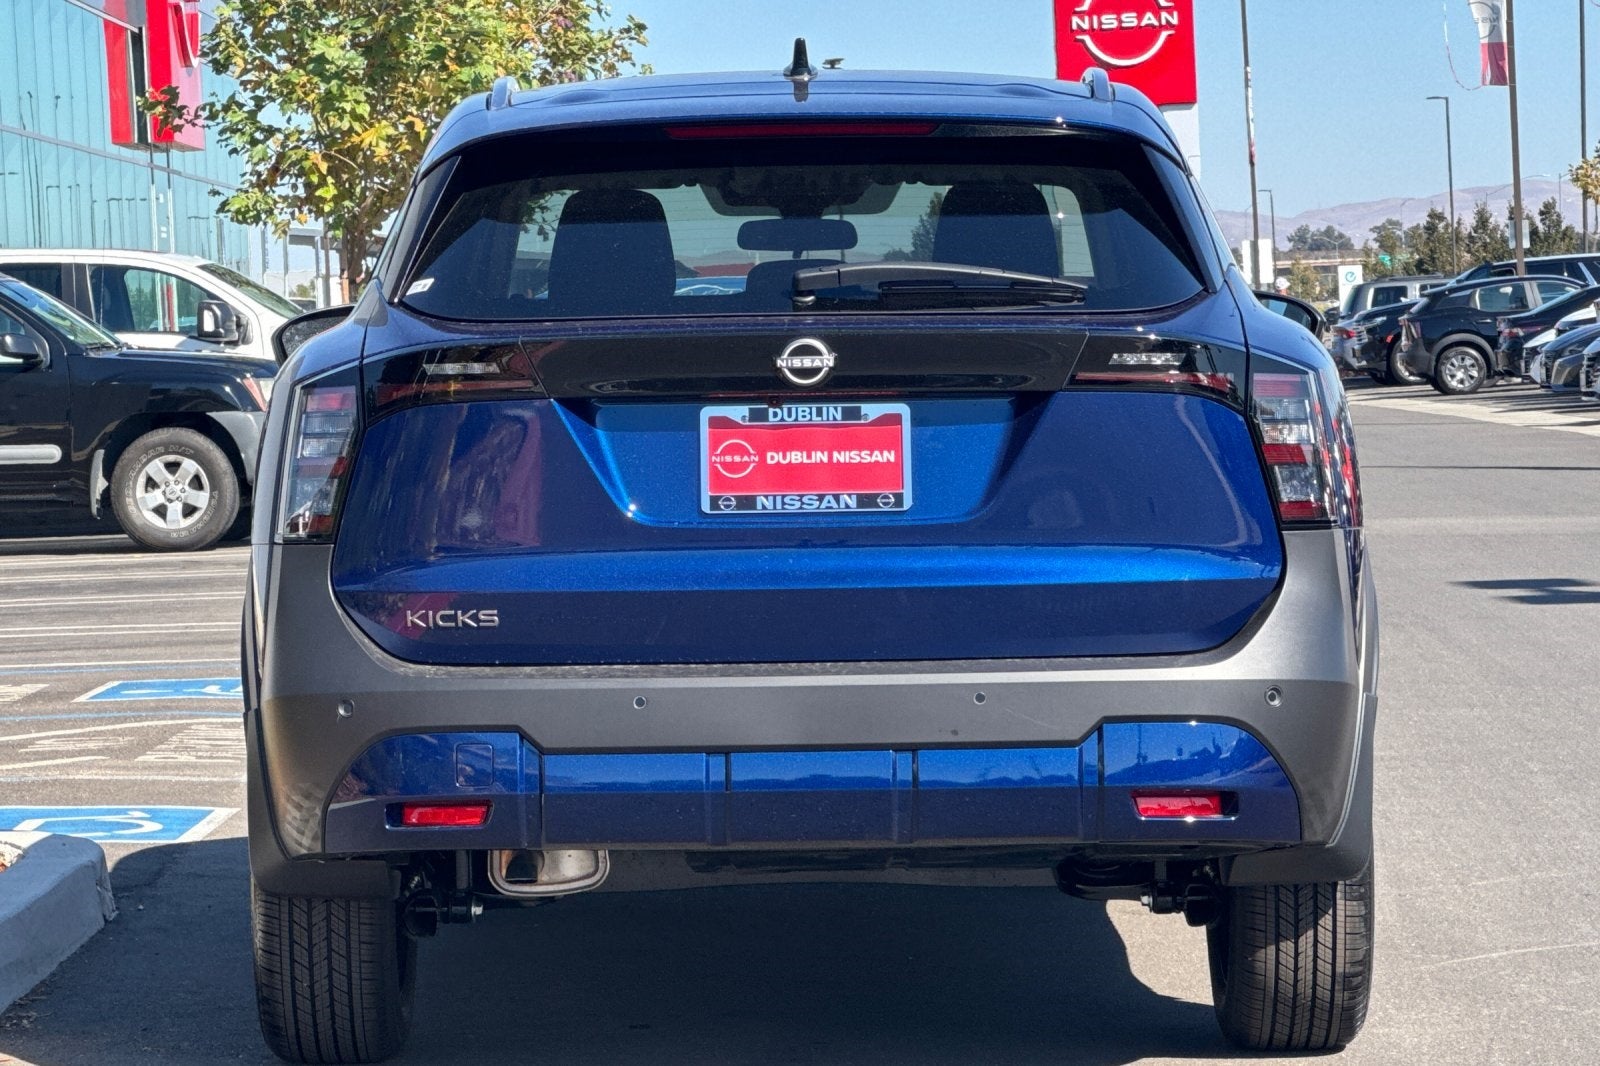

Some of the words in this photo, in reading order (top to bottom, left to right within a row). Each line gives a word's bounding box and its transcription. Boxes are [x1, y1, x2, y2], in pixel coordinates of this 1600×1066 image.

[1071, 11, 1179, 30] NISSAN
[777, 358, 834, 367] NISSAN
[768, 406, 842, 422] DUBLIN
[712, 454, 759, 463] NISSAN
[766, 451, 829, 464] DUBLIN
[832, 450, 895, 463] NISSAN
[756, 494, 857, 510] NISSAN
[406, 609, 500, 627] KICKS
